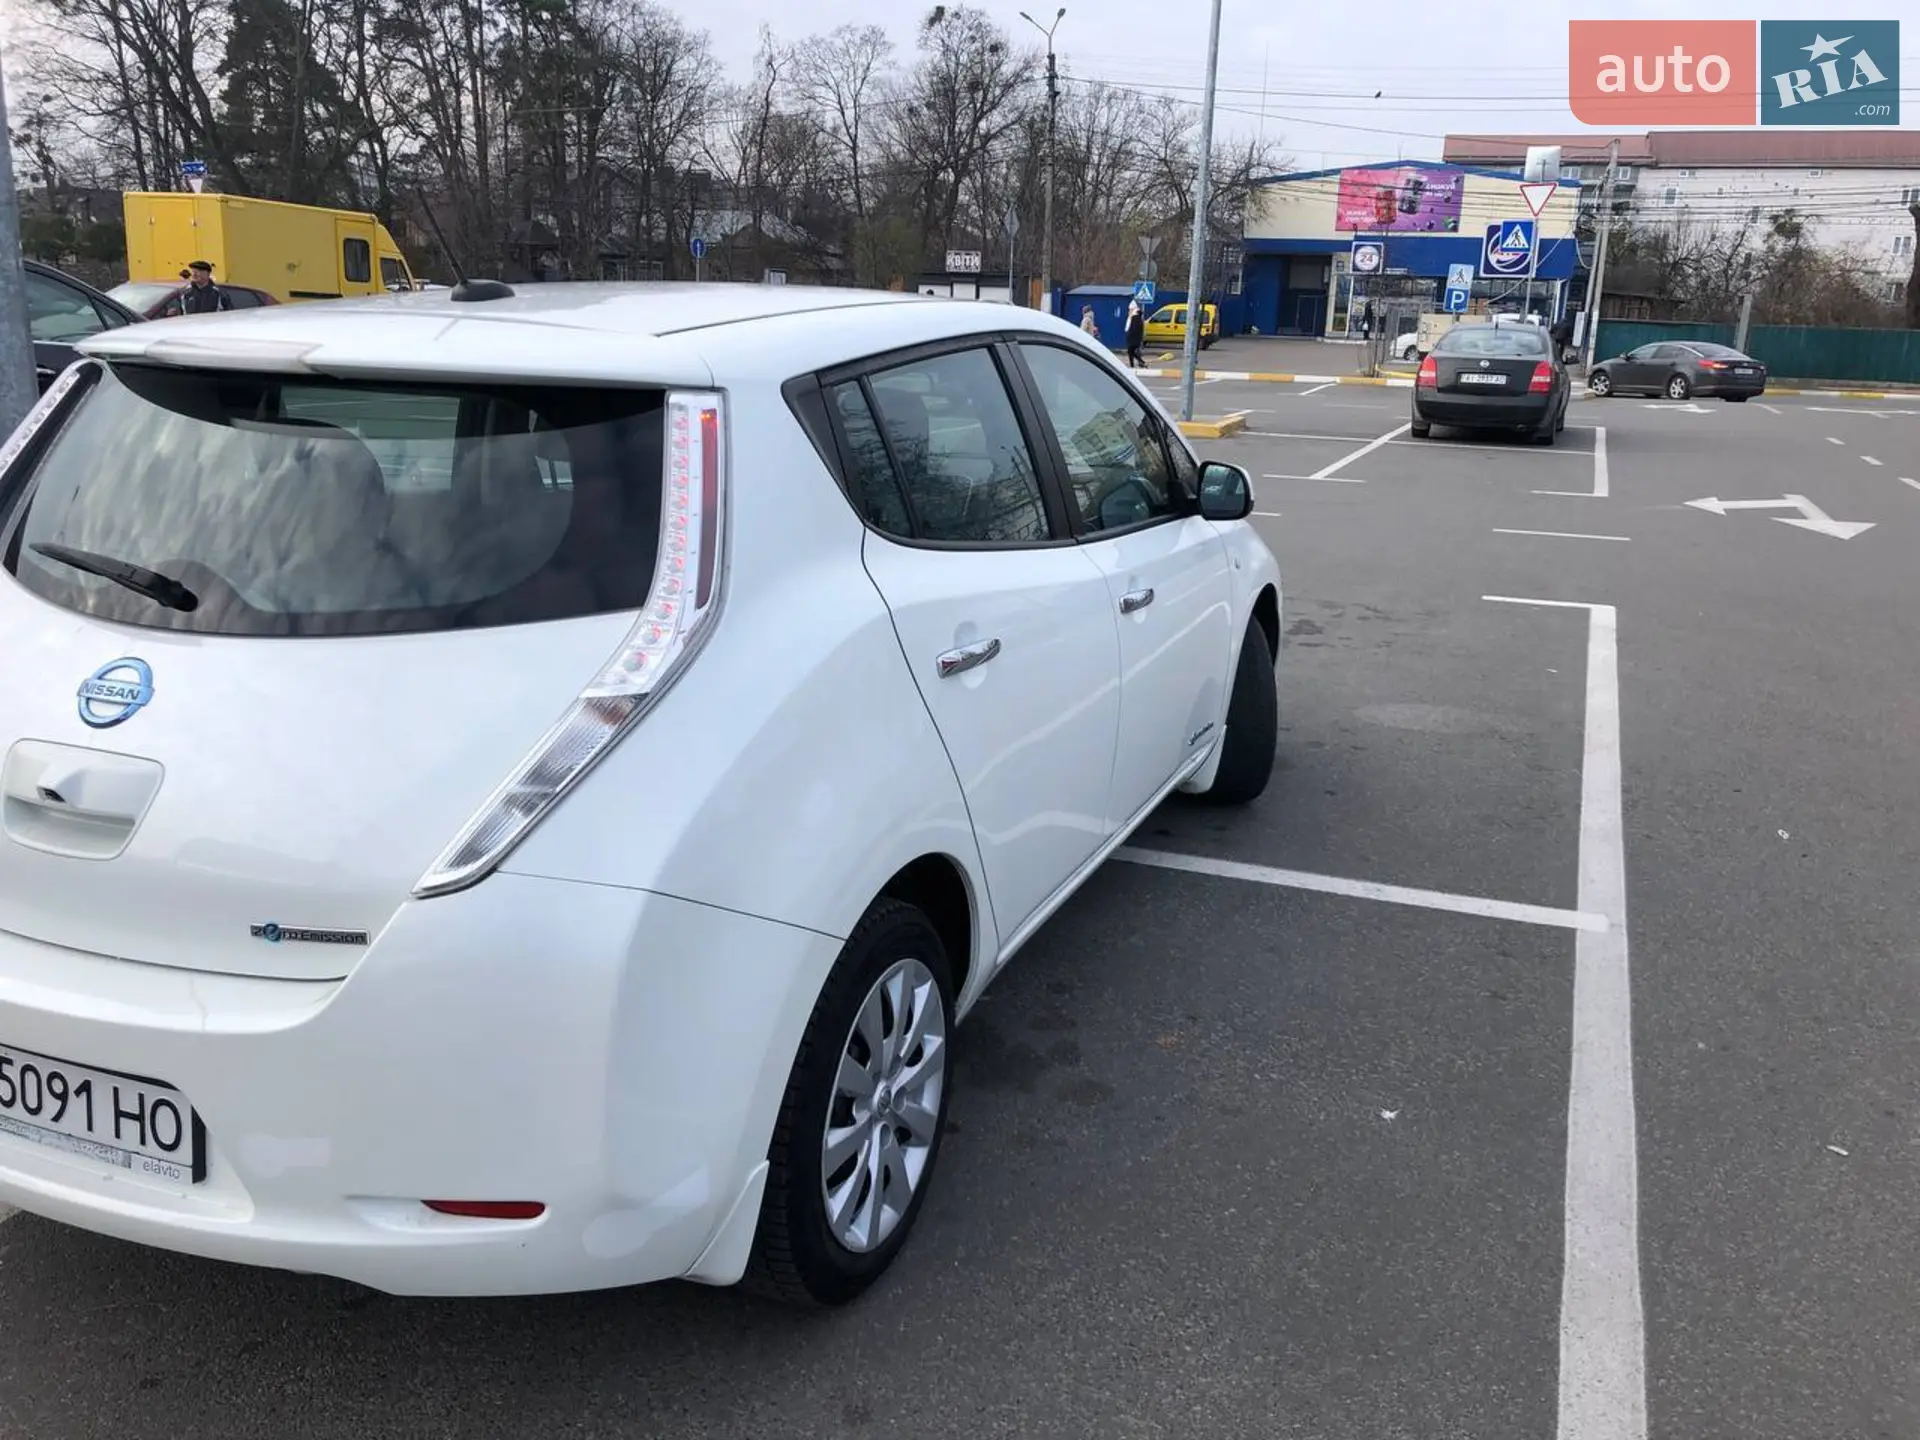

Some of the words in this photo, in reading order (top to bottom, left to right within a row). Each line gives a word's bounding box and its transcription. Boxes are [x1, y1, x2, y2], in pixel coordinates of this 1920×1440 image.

[1359, 251, 1374, 264] 24
[1451, 291, 1465, 310] P
[82, 682, 140, 701] NISSAN
[0, 1055, 94, 1133] 5091
[112, 1085, 183, 1153] HO
[142, 1158, 181, 1180] elavto
